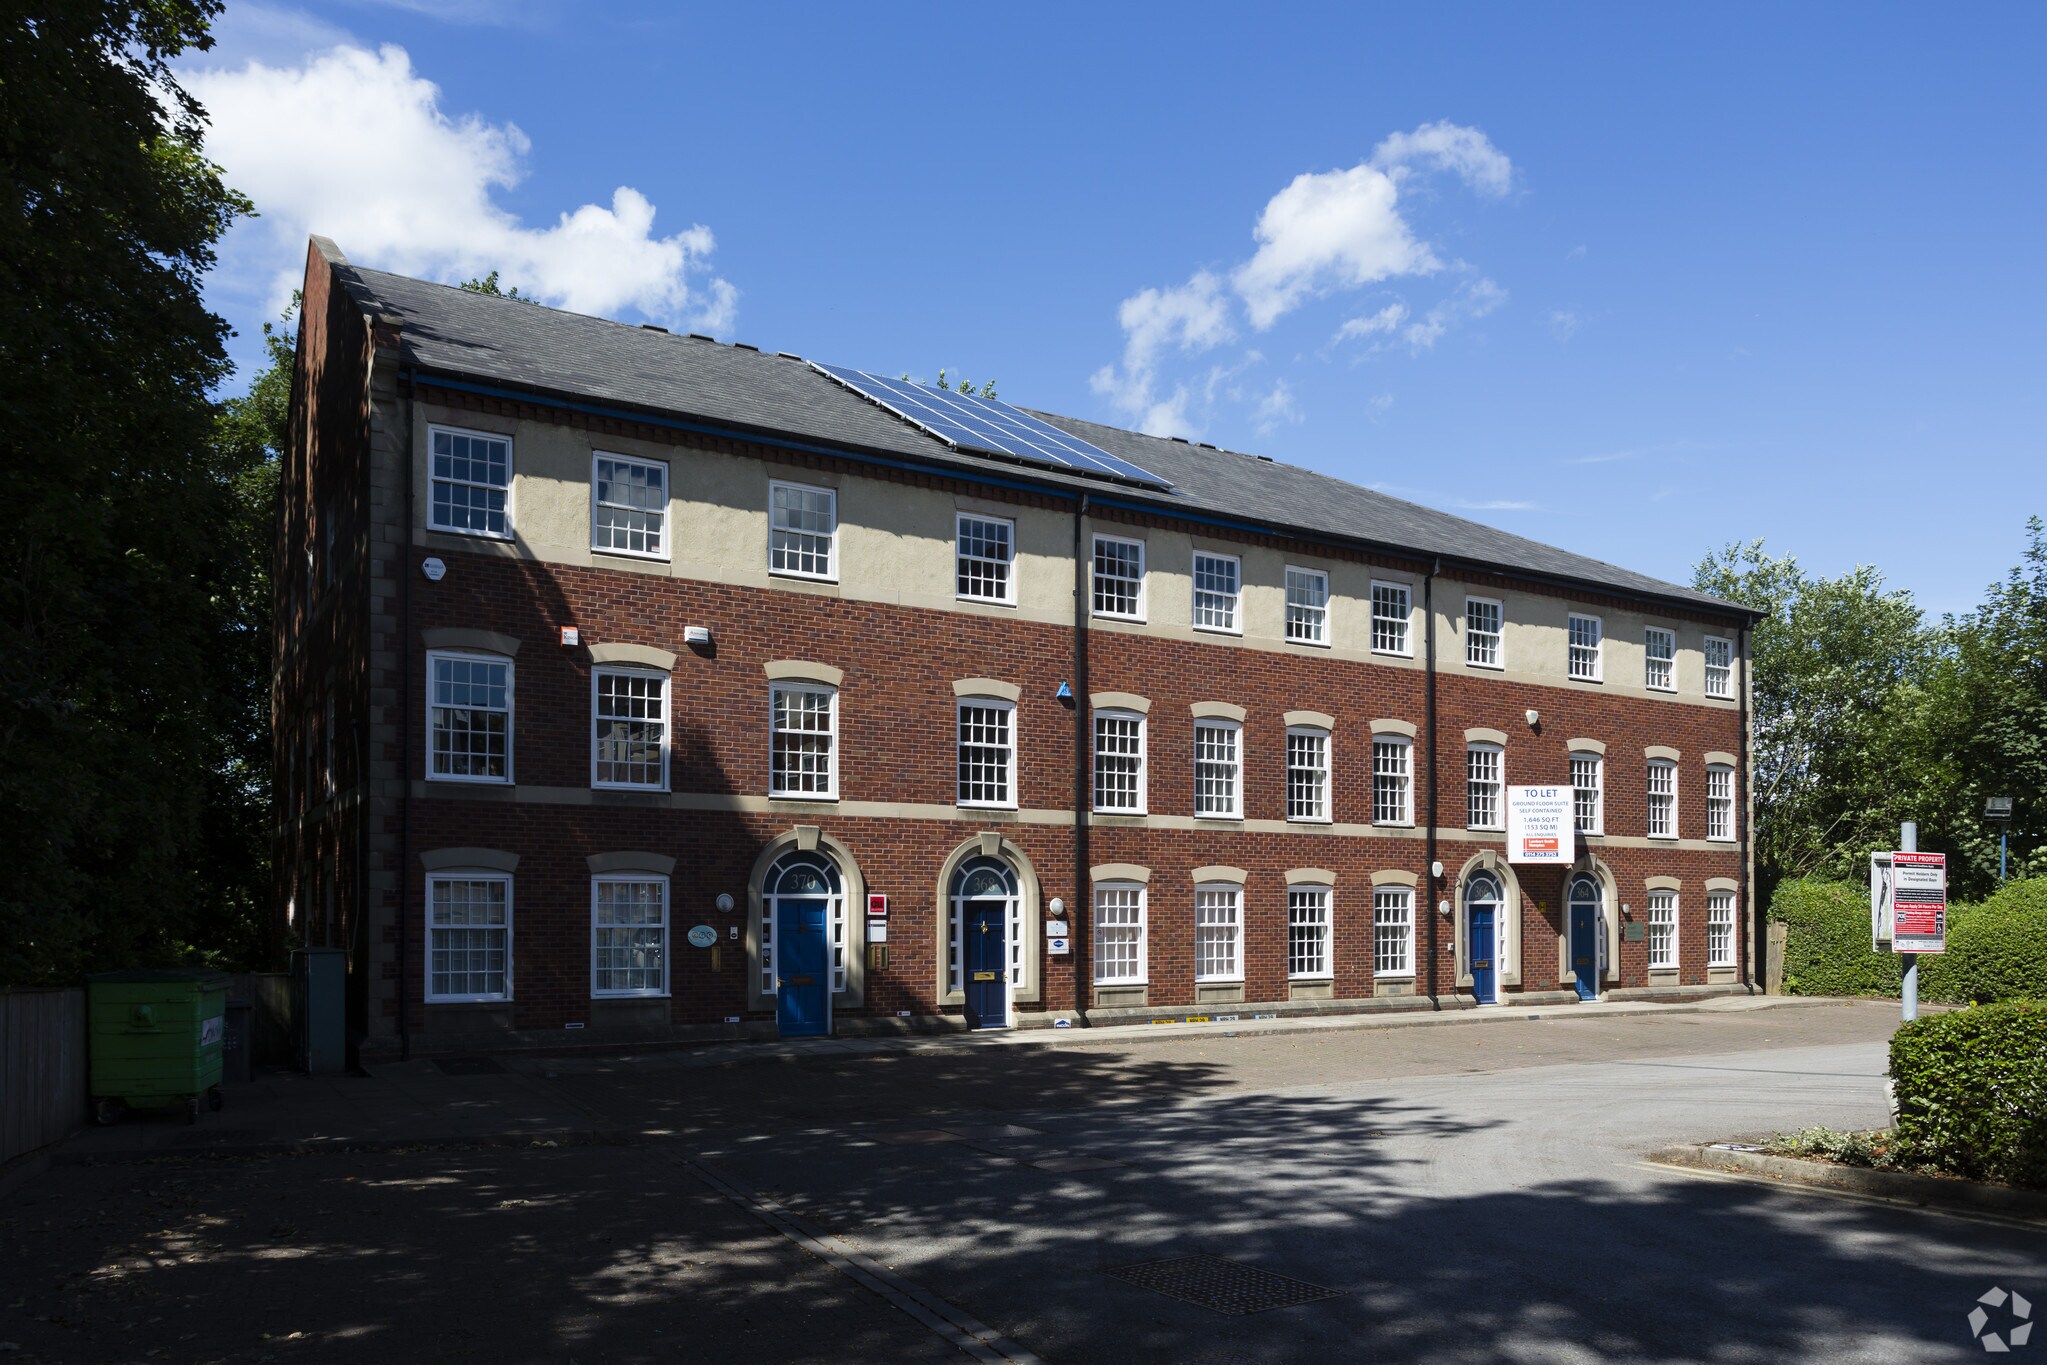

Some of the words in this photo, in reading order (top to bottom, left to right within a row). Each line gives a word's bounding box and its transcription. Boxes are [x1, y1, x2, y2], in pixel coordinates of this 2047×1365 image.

[791, 873, 815, 889] 370
[974, 876, 995, 891] 368
[1475, 886, 1488, 897] 366
[1576, 887, 1588, 898] 364
